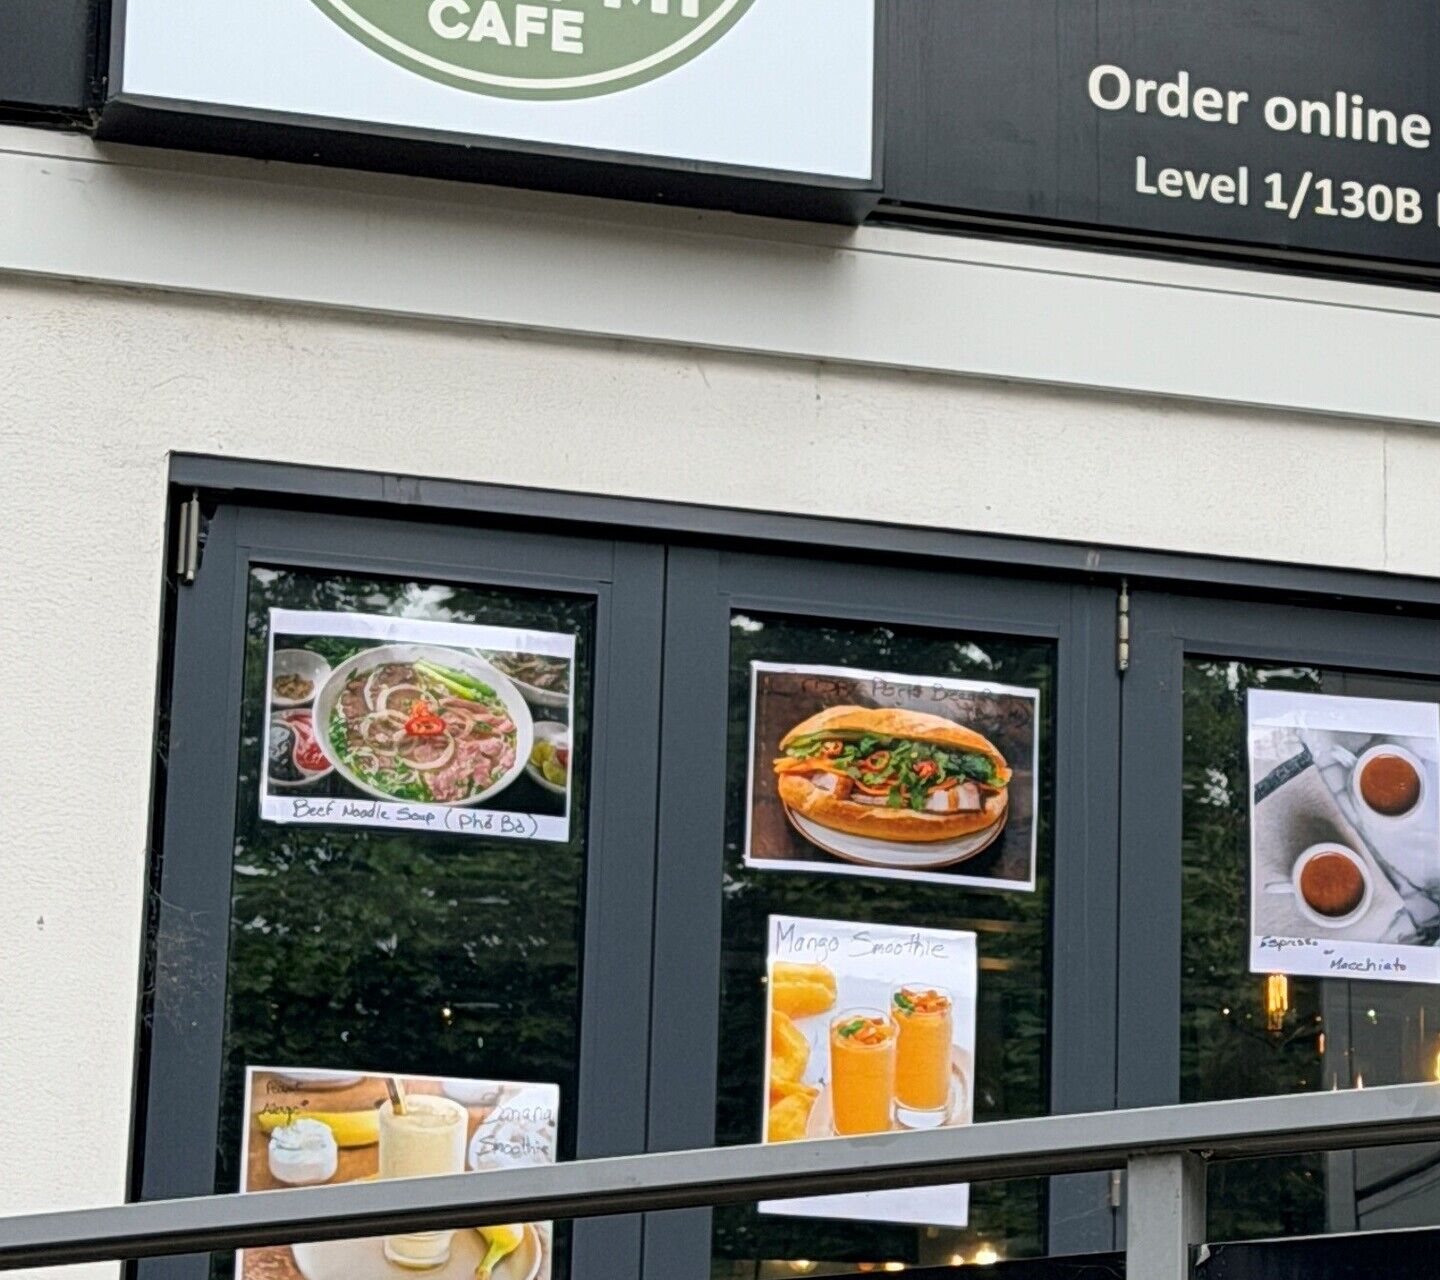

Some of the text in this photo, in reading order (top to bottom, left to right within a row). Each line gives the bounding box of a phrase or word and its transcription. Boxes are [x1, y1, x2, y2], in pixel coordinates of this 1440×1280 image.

[1088, 64, 1249, 125] Order
[1264, 91, 1431, 149] online
[1135, 155, 1248, 206] Level
[1264, 171, 1423, 224] 1/130B
[292, 798, 336, 819] Beef
[341, 800, 391, 821] Noodle
[395, 806, 436, 825] Soup
[774, 919, 950, 963] Mango Smoothie
